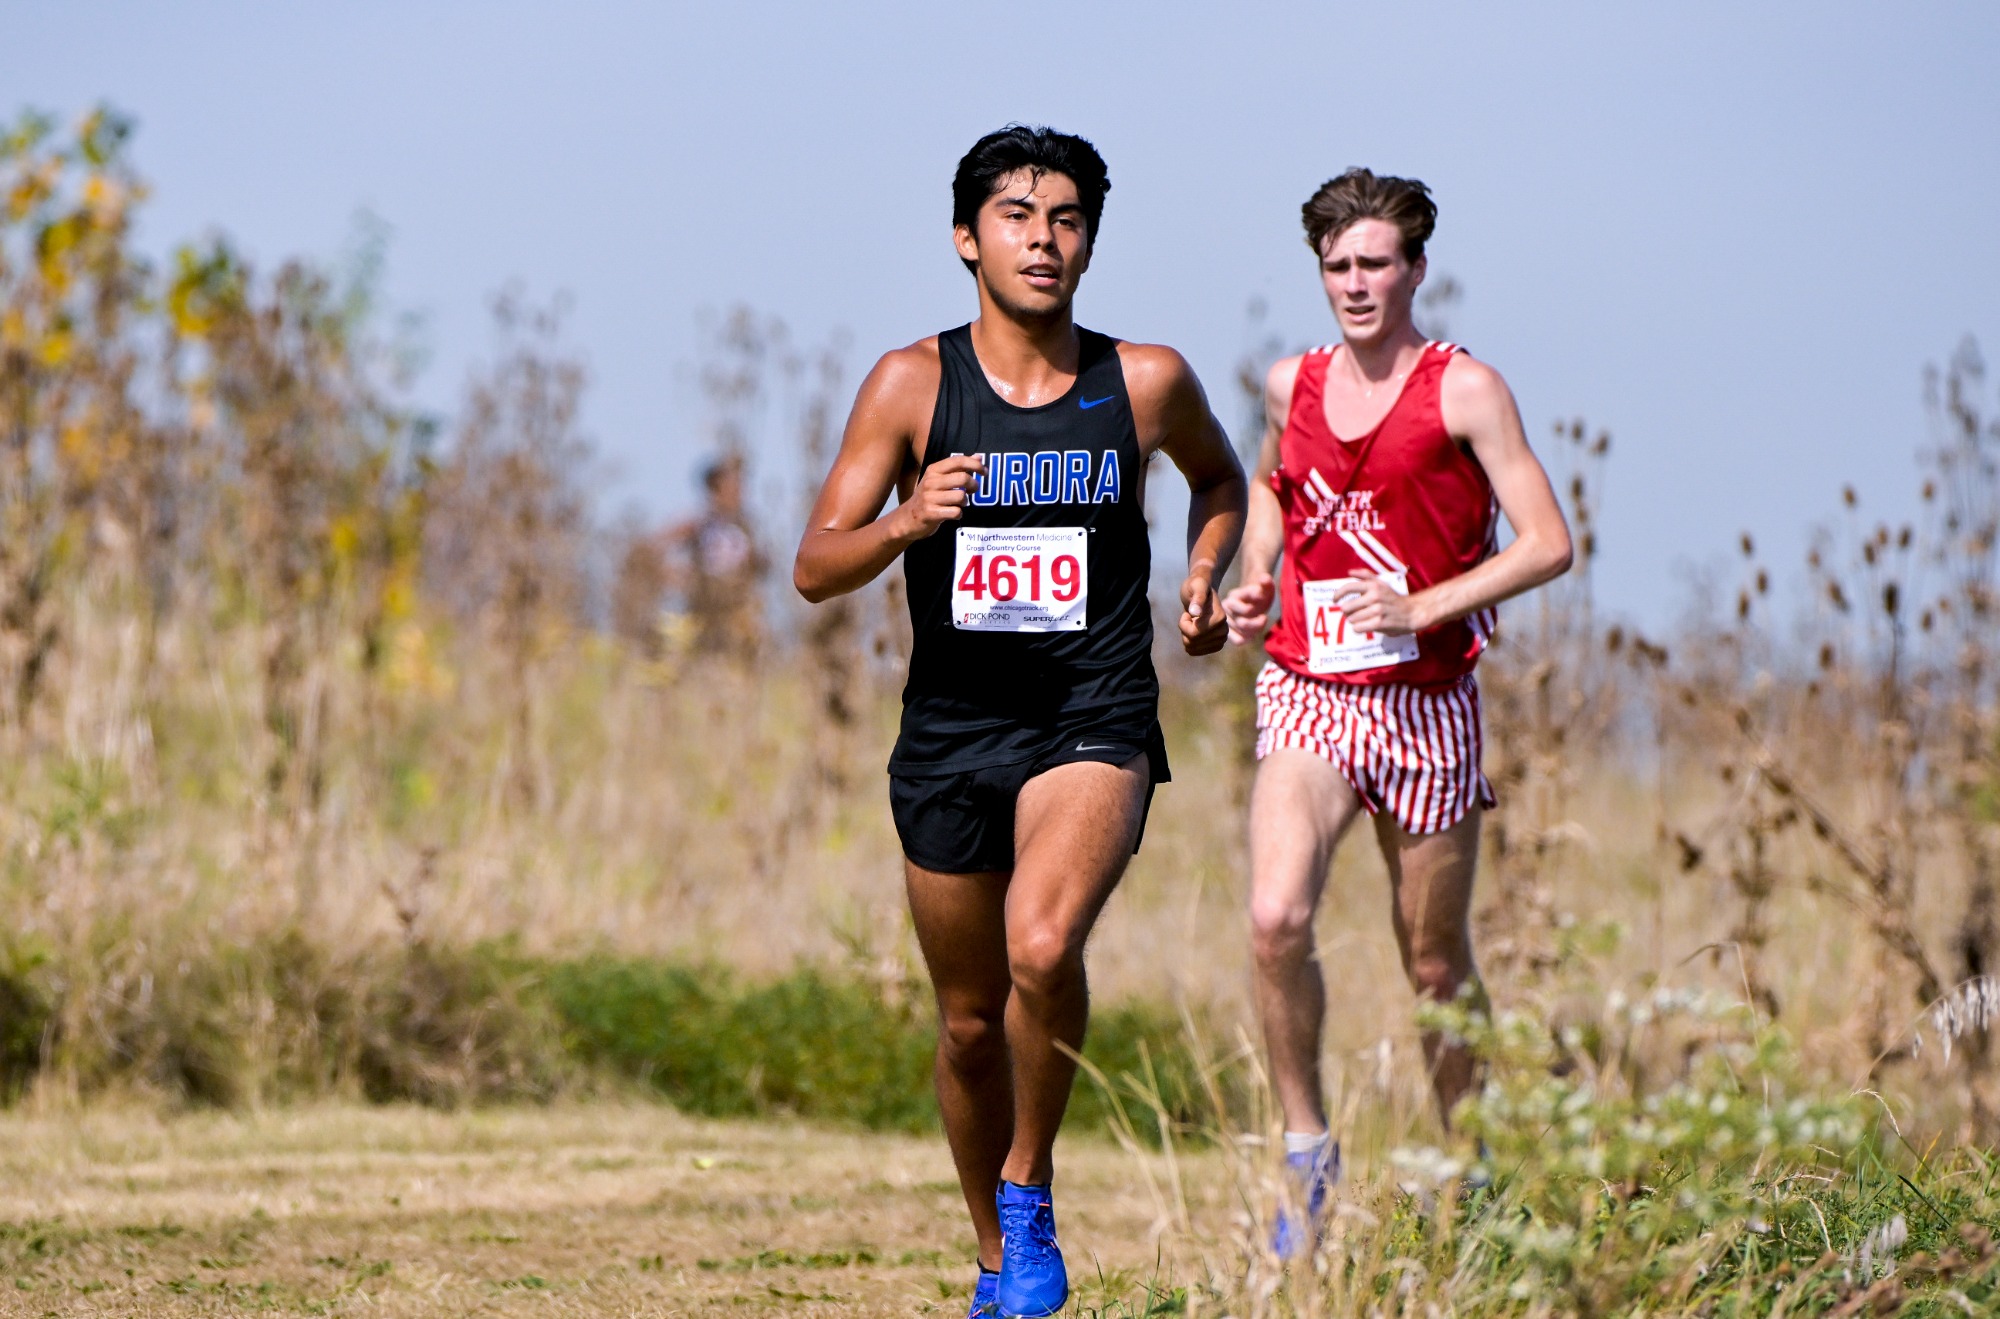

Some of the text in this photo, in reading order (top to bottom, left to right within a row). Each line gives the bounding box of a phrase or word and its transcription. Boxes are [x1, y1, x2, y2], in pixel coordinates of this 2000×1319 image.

[950, 450, 1121, 507] URORA
[1303, 510, 1386, 536] CTRAL
[977, 533, 1035, 542] Northwestern
[1036, 533, 1072, 542] Medicine
[966, 544, 1042, 552] Cross Country Course
[958, 554, 1081, 602] 4619
[969, 613, 1011, 621] DICK POND
